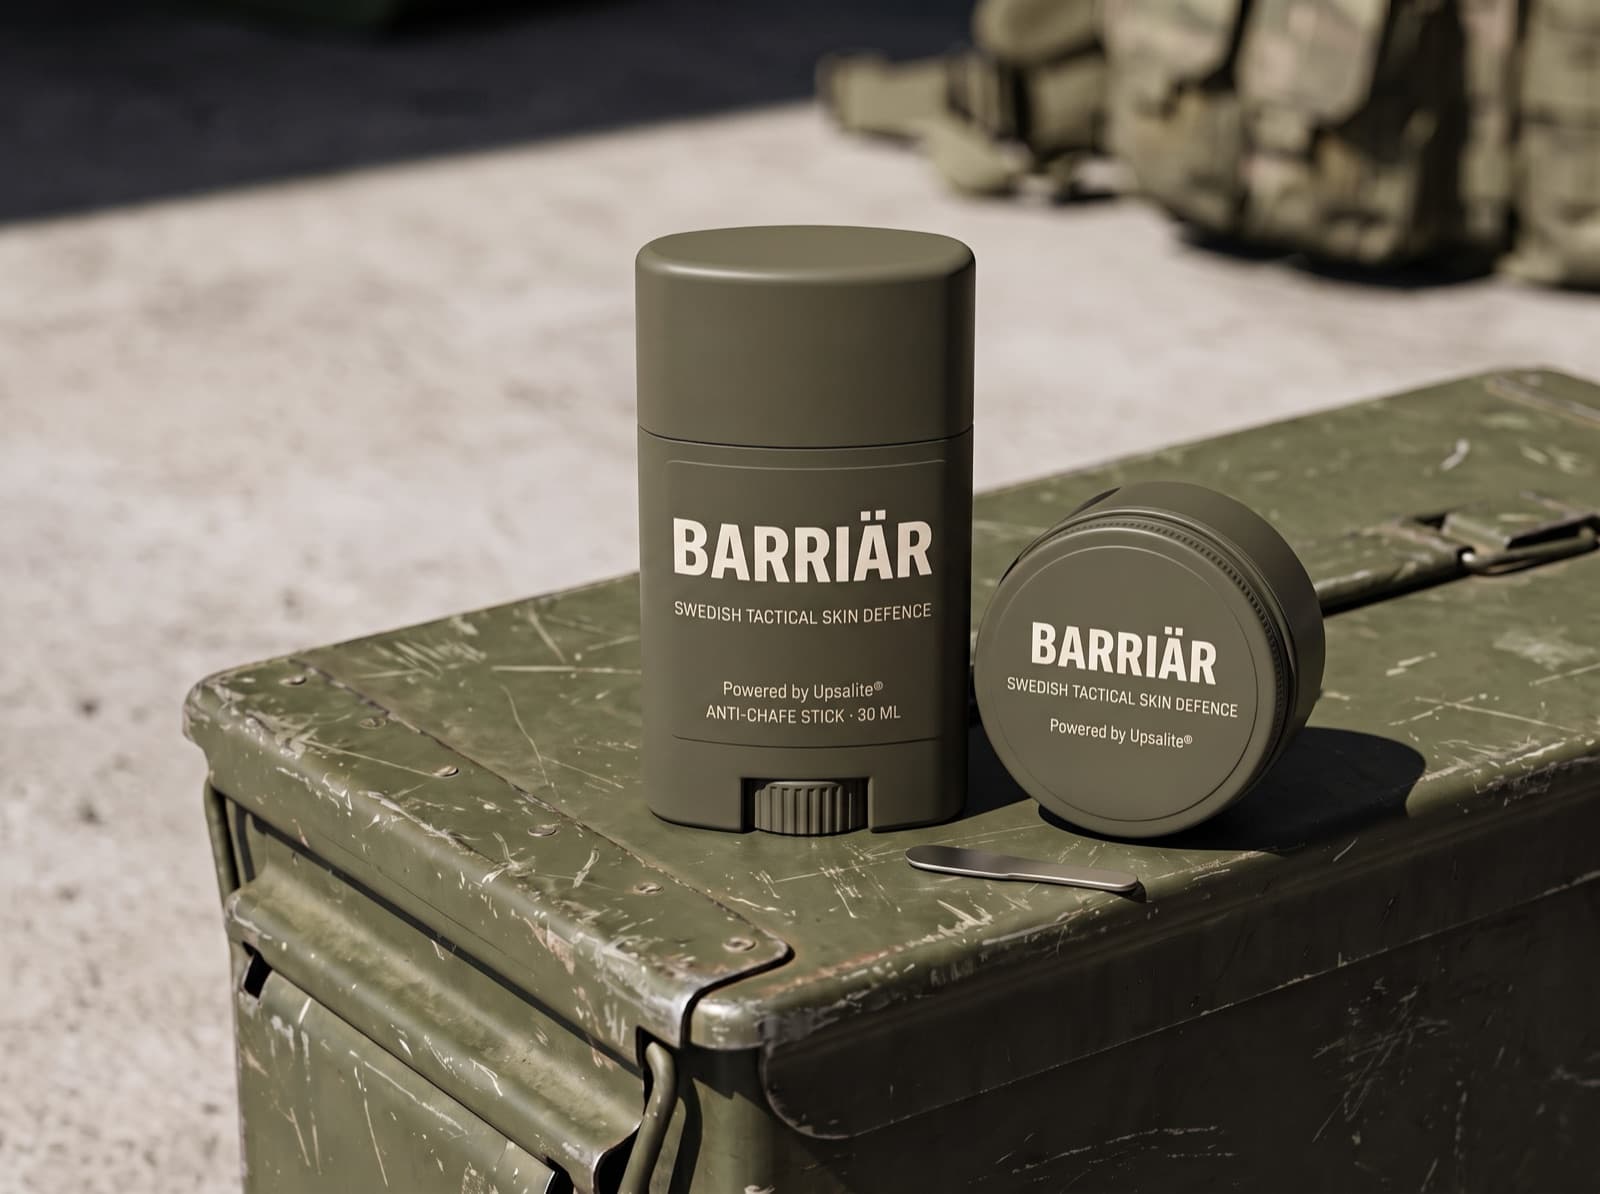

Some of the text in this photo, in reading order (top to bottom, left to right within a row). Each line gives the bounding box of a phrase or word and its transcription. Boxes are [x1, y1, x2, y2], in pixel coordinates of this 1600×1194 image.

[673, 509, 933, 584] BARRIÄR
[674, 600, 932, 625] SWEDISH TACTICAL SKIN DEFENCE
[1031, 621, 1217, 685] BARRIÄR
[723, 680, 787, 699] Powered
[791, 683, 809, 704] by
[1007, 676, 1239, 718] SWEDISH TACTICAL SKIN DEFENCE
[705, 704, 797, 724] ANTI-CHAFE
[801, 708, 845, 724] STICK
[857, 706, 876, 723] 30
[880, 704, 901, 721] ML
[1050, 717, 1107, 740] Powered
[1110, 725, 1127, 745] by
